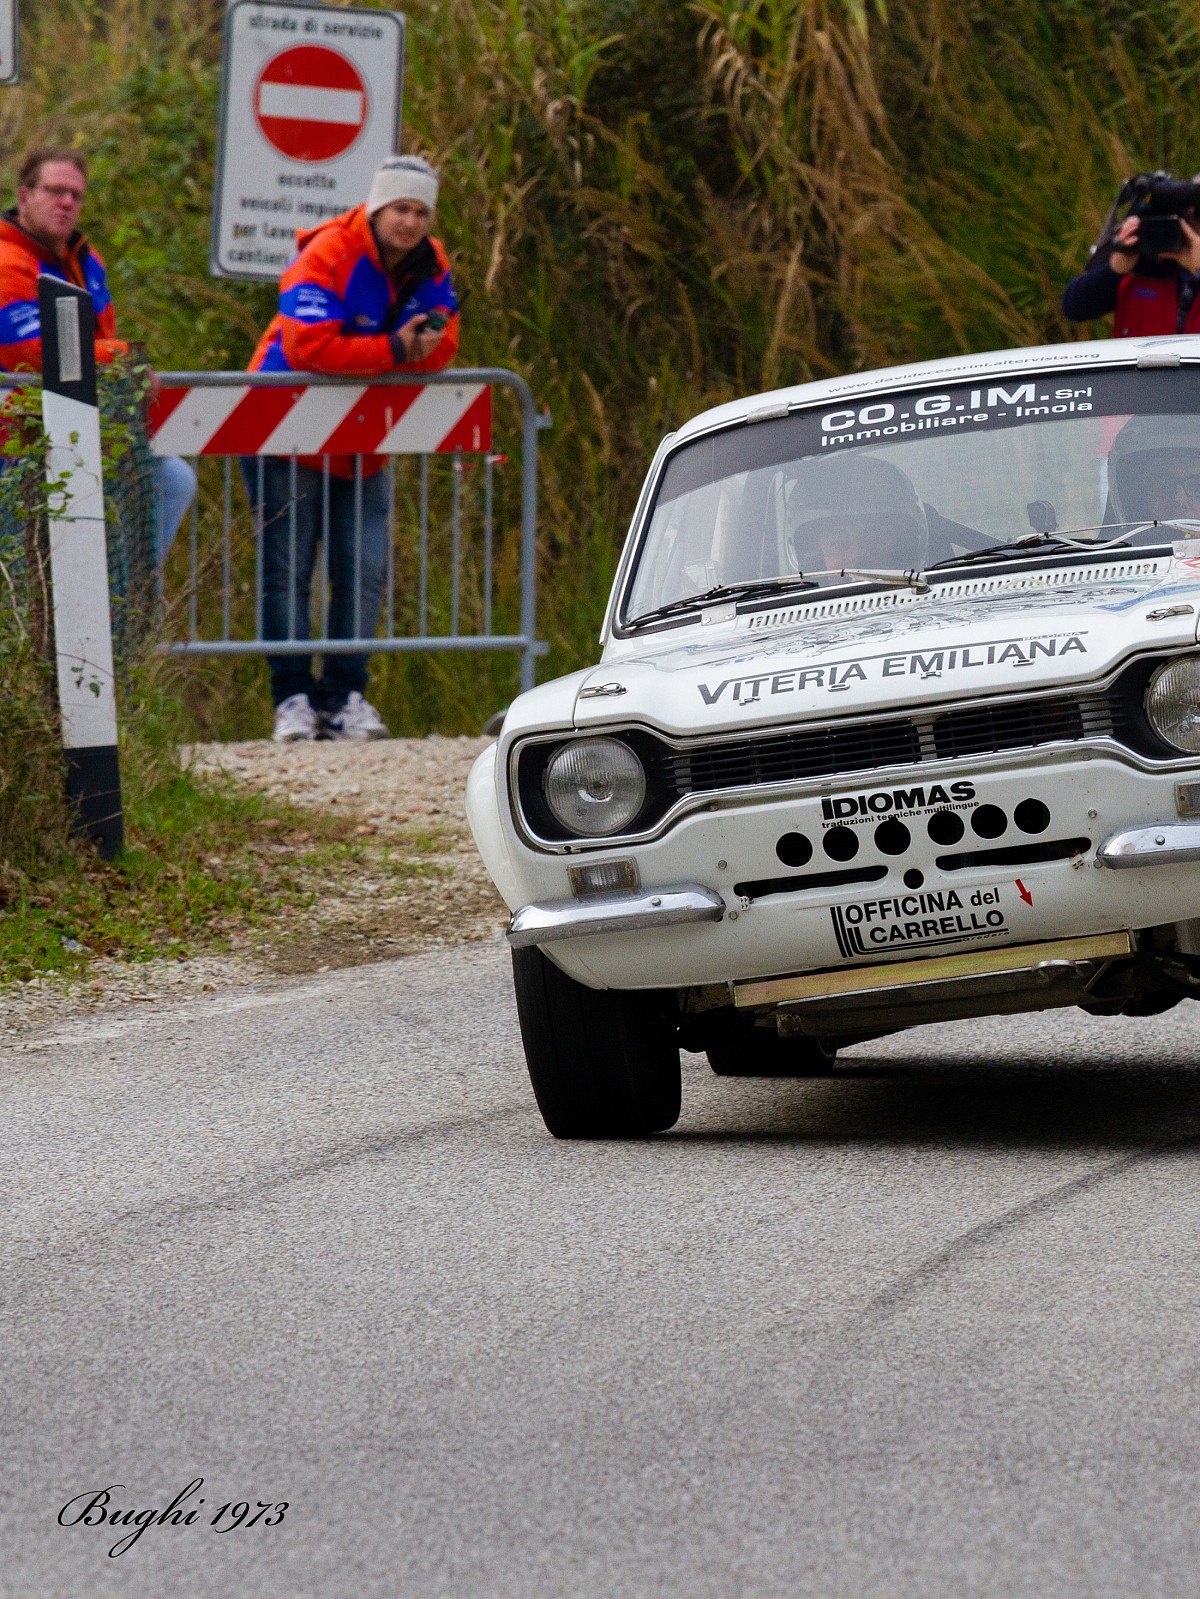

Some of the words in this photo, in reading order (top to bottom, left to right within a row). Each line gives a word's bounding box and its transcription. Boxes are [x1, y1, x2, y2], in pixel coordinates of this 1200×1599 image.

[249, 14, 298, 32] strada
[304, 17, 318, 33] di
[324, 22, 383, 40] servizio
[240, 197, 293, 213] veicoli
[233, 223, 257, 239] per
[820, 383, 1049, 432] CO.G.IM.
[1054, 387, 1093, 400] Srl
[820, 412, 989, 447] Immobiliare
[1015, 401, 1093, 418] Imola
[697, 663, 868, 706] VITERIA
[881, 636, 1088, 679] EMILIANA
[820, 780, 977, 821] IDIOMAS
[821, 815, 875, 829] traduzioni
[876, 808, 922, 823] tecniche
[923, 801, 980, 815] multilingue
[845, 889, 963, 925] OFFICINA
[970, 887, 1001, 907] del
[869, 909, 1005, 944] CARRELLO
